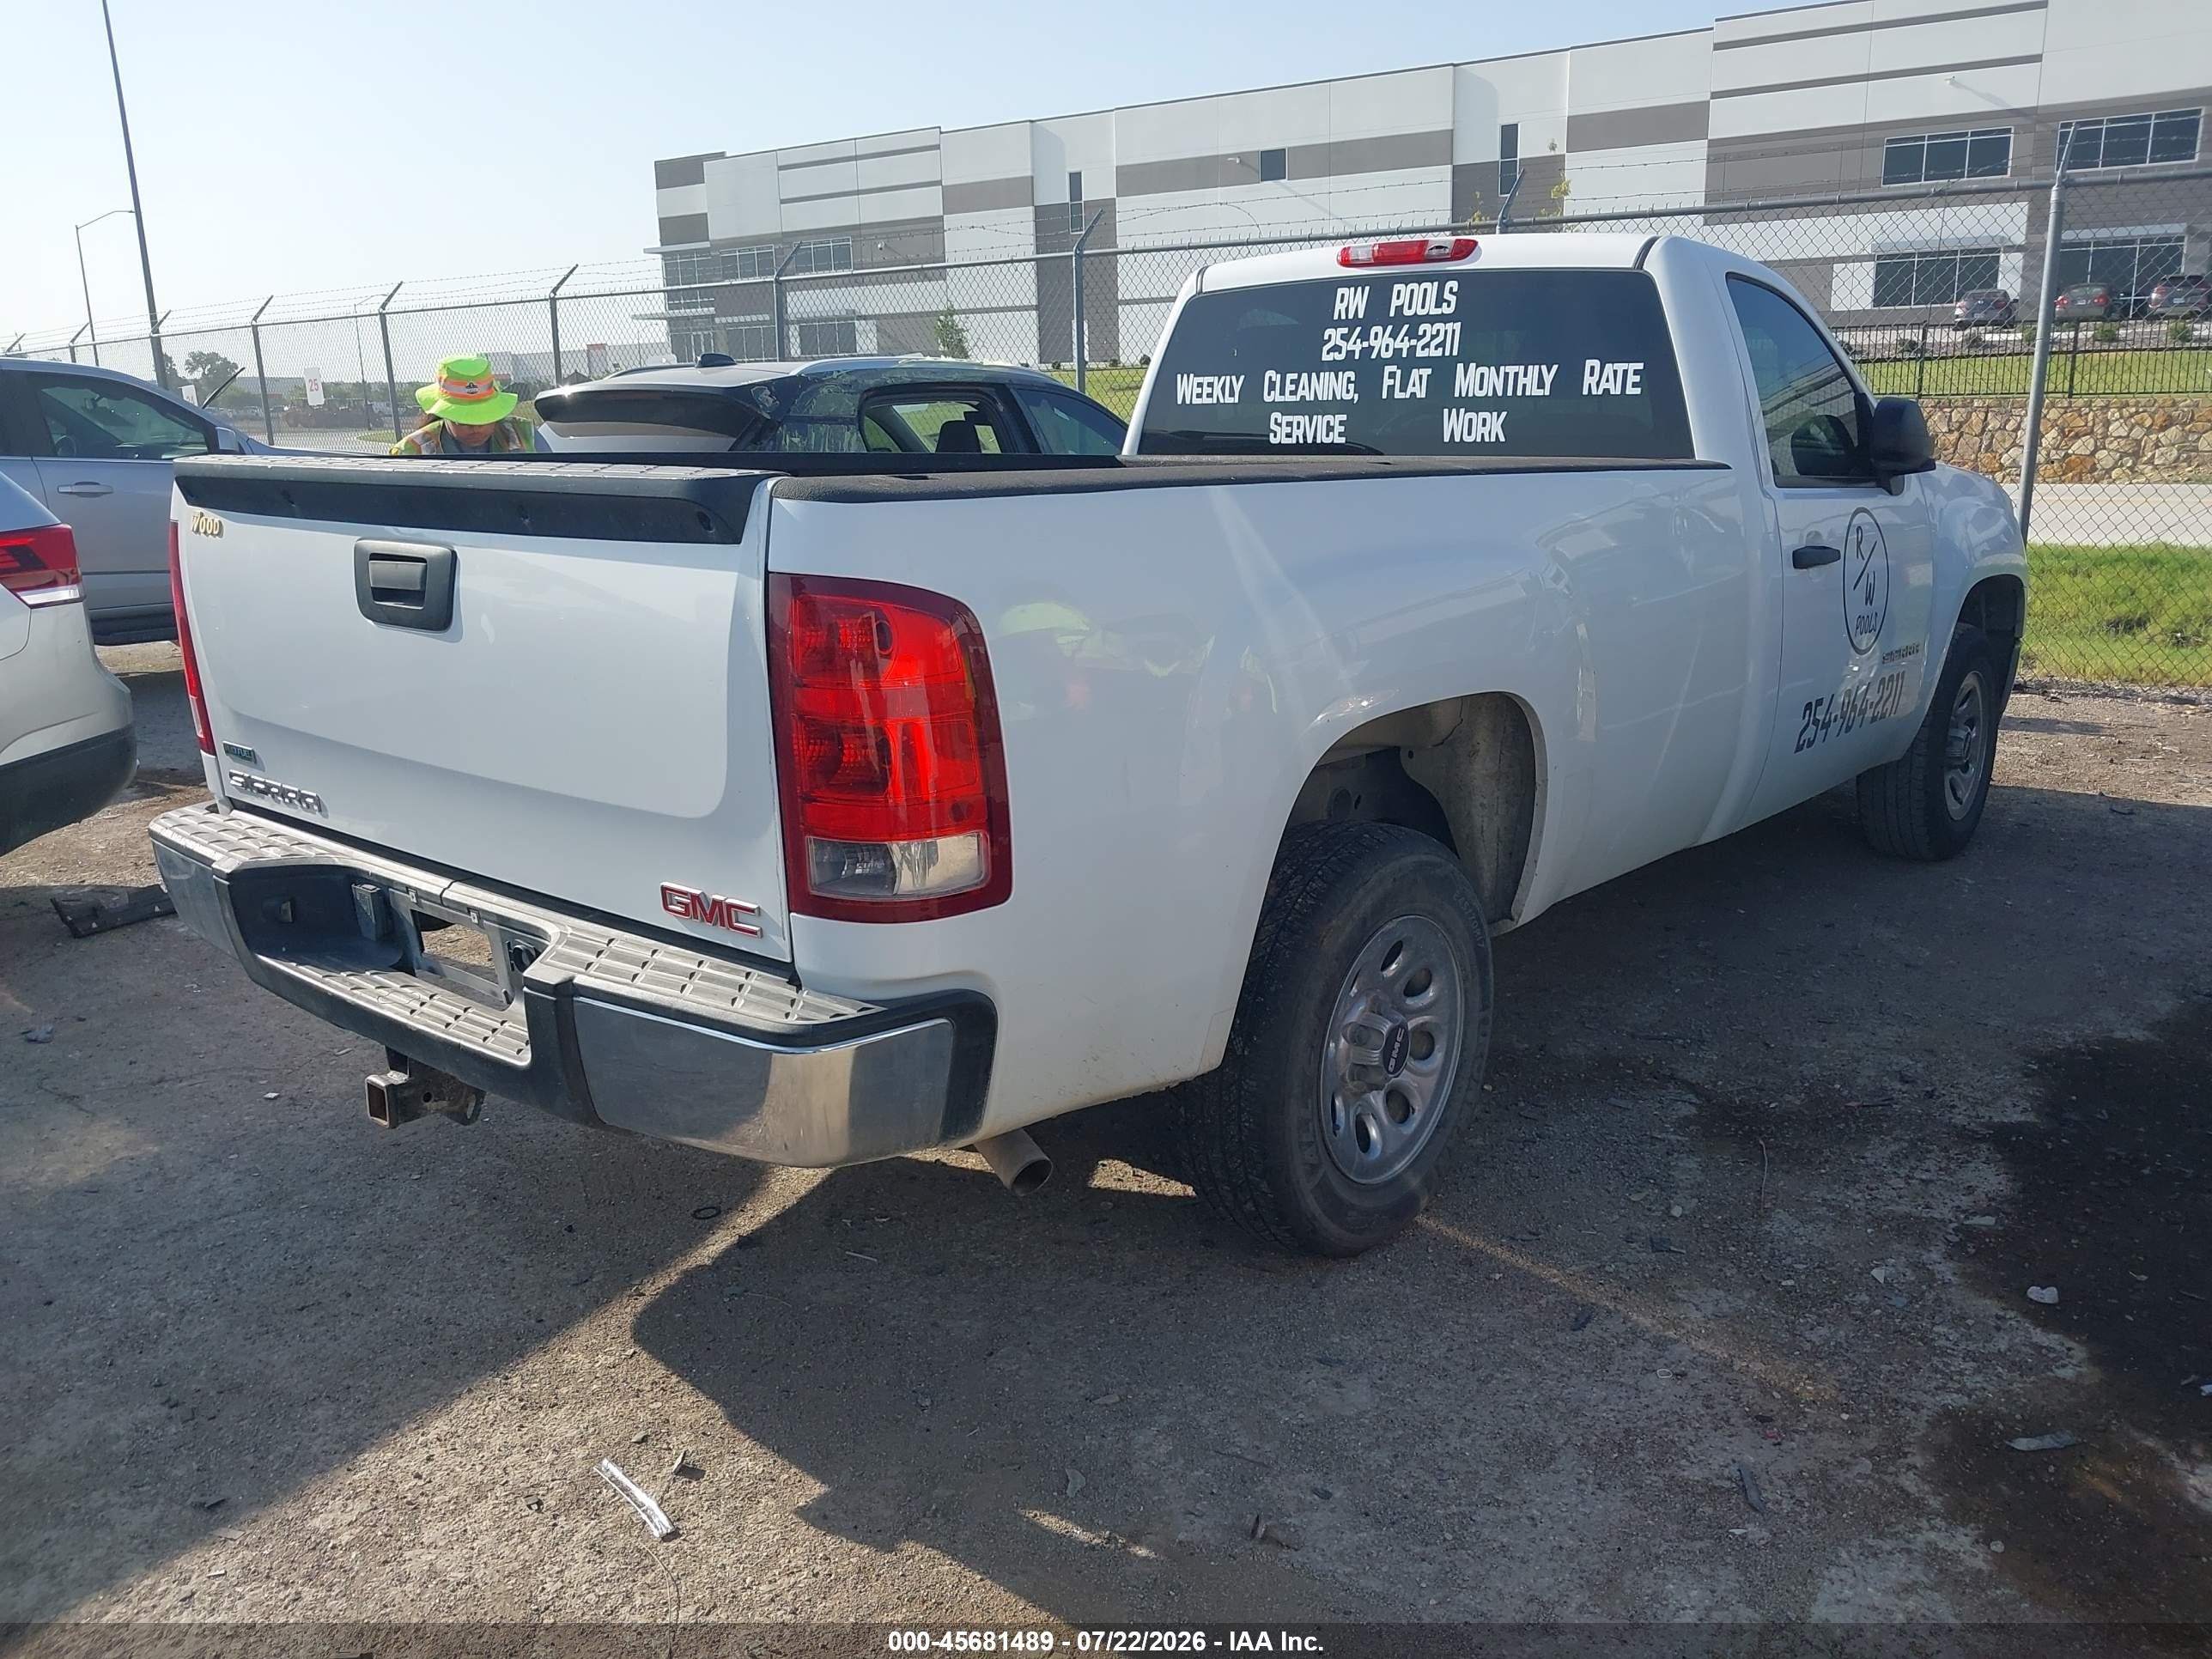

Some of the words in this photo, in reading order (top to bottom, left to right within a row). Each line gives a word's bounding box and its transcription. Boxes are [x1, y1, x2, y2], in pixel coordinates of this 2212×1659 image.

[1334, 285, 1370, 320] RW
[1389, 280, 1459, 318] POOLS
[1321, 321, 1462, 362] 254-964-2211
[1855, 611, 1878, 637] POOLS
[1794, 667, 1906, 754] 254-964-2211
[659, 881, 763, 939] GMC
[1388, 1027, 1406, 1073] GMC
